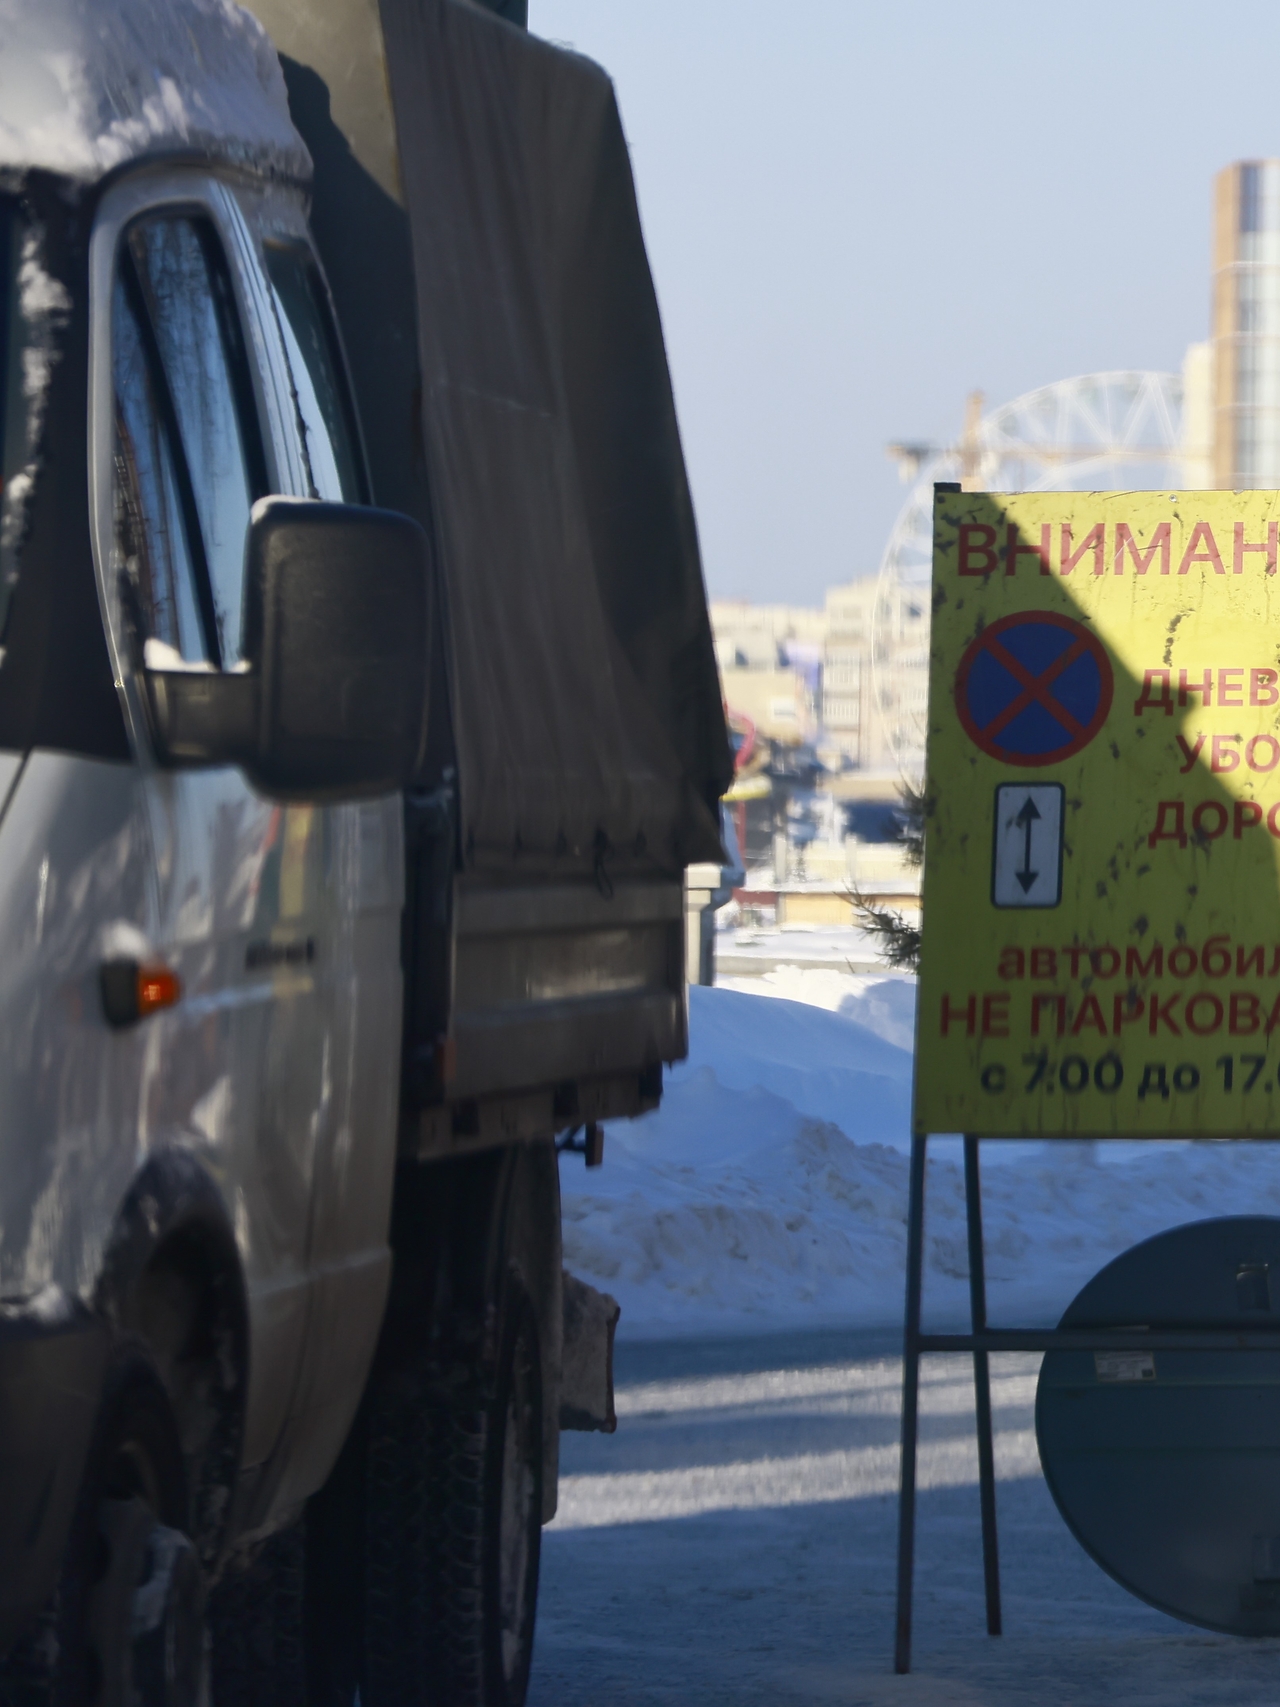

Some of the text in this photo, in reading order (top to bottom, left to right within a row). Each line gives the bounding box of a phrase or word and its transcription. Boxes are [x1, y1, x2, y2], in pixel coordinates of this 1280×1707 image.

[939, 991, 1011, 1037] НЕ
[981, 1064, 1006, 1094] с
[1022, 1053, 1124, 1094] 7.00
[1138, 1062, 1199, 1101] до
